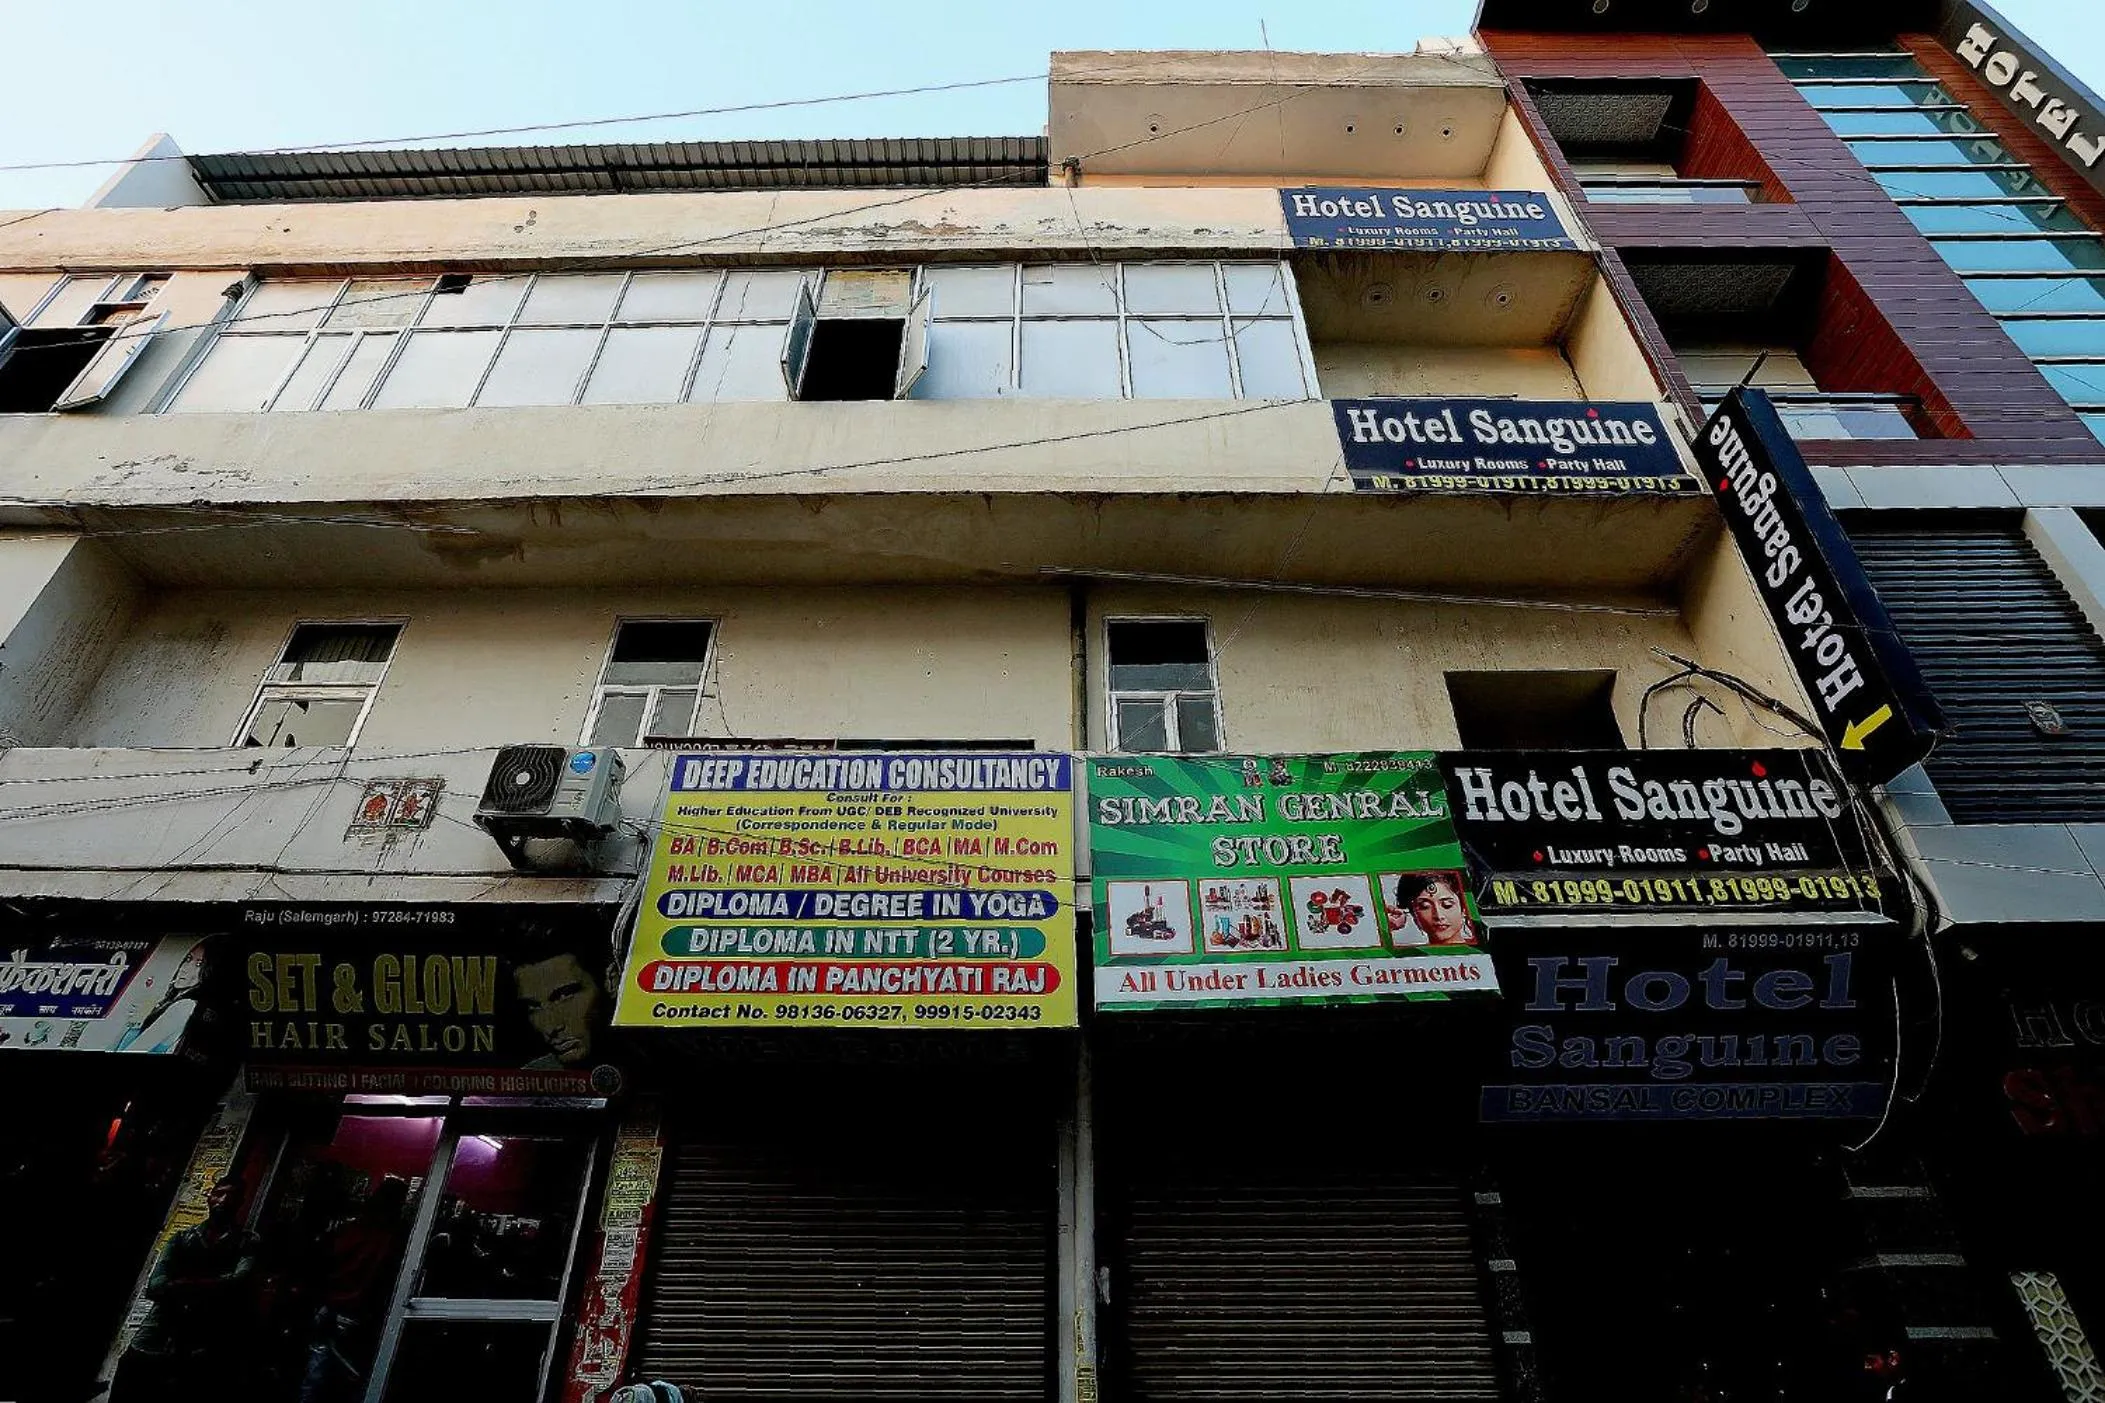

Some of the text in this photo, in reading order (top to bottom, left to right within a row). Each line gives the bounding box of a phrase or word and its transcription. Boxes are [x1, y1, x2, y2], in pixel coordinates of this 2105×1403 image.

[1956, 22, 2105, 168] HOTEL
[1291, 194, 1546, 224] Hotel Sanguine
[1347, 226, 1519, 239] Luxury Rooms Party Hall
[1347, 407, 1657, 454] Hotel Sanguine
[1417, 457, 1626, 473] Luxury Rooms Party Hall
[1709, 414, 1865, 713] Hotel Sanguine
[682, 757, 1060, 790] DEEP EDUCATION CONSULTANCY
[1096, 765, 1154, 778] Rakesh
[677, 806, 722, 818] Higher
[727, 806, 793, 817] Education
[799, 806, 832, 817] From
[875, 806, 902, 817] DEB
[907, 805, 985, 819] Recognized
[990, 805, 1058, 819] University
[826, 793, 878, 804] Consult
[883, 793, 904, 804] For
[1099, 790, 1445, 825] SIMRAN GENRAL
[1455, 761, 1841, 835] Hotel Sanguine
[736, 818, 998, 833] (Correspondence & Regular Mode)
[902, 837, 942, 856] BCA
[953, 837, 982, 856] MA
[994, 837, 1058, 856] M.Com
[1211, 834, 1348, 867] STORE
[1549, 842, 1809, 867] Luxury Rooms Party Hall
[735, 864, 778, 883] MCA
[789, 864, 832, 884] MBA
[875, 864, 971, 887] University
[977, 865, 1057, 884] Courses
[667, 893, 789, 917] DIPLOMA
[814, 893, 924, 918] DEGREE
[932, 893, 961, 917] IN
[969, 892, 1047, 917] YOGA
[1493, 881, 1528, 906] M.
[244, 909, 275, 925] Raju
[278, 909, 360, 926] (Salemgarh)
[371, 910, 456, 925] 97284-71983
[688, 927, 1020, 959] DIPLOMA IN NTT (2 YR.)
[1703, 933, 1722, 948] M.
[247, 953, 498, 1015] SET & GLOW
[653, 965, 1046, 993] DIPLOMA IN PANCHYATI RAJ
[1118, 962, 1482, 994] All Under Ladies Garments
[1525, 952, 1858, 1011] Hotel
[652, 1003, 1042, 1022] Contact No. 98136-06327, 99915-02343
[249, 1022, 497, 1053] HAIR SALON
[1510, 1023, 1862, 1079] Sanguine
[501, 1075, 588, 1094] HIGHLIGHTS
[1507, 1086, 1854, 1114] BANSAL COMPLEX
